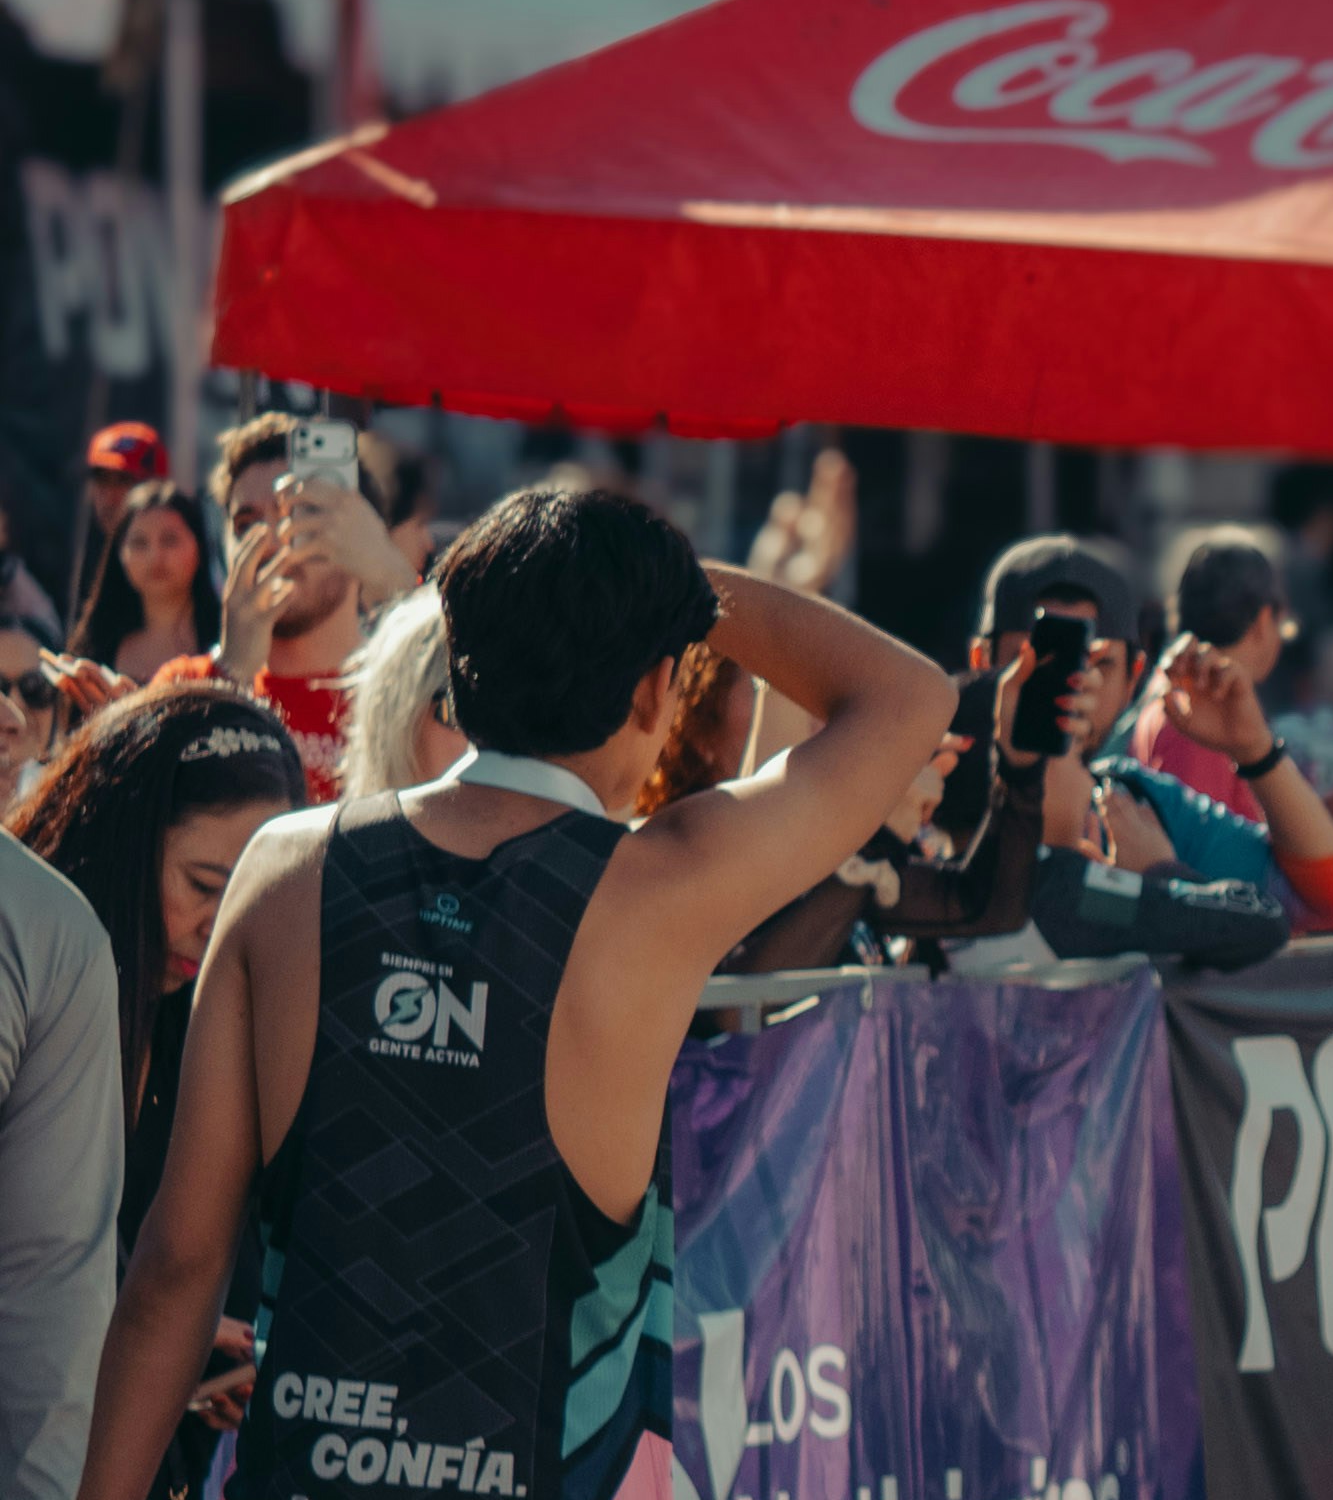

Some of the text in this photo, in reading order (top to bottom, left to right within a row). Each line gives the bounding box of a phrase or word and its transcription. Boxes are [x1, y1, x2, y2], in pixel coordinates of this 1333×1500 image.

[374, 970, 489, 1052] ON
[369, 1037, 481, 1069] GENTE ACTIVA
[273, 1372, 408, 1434] CREE,
[311, 1434, 527, 1498] CONFÍA.
